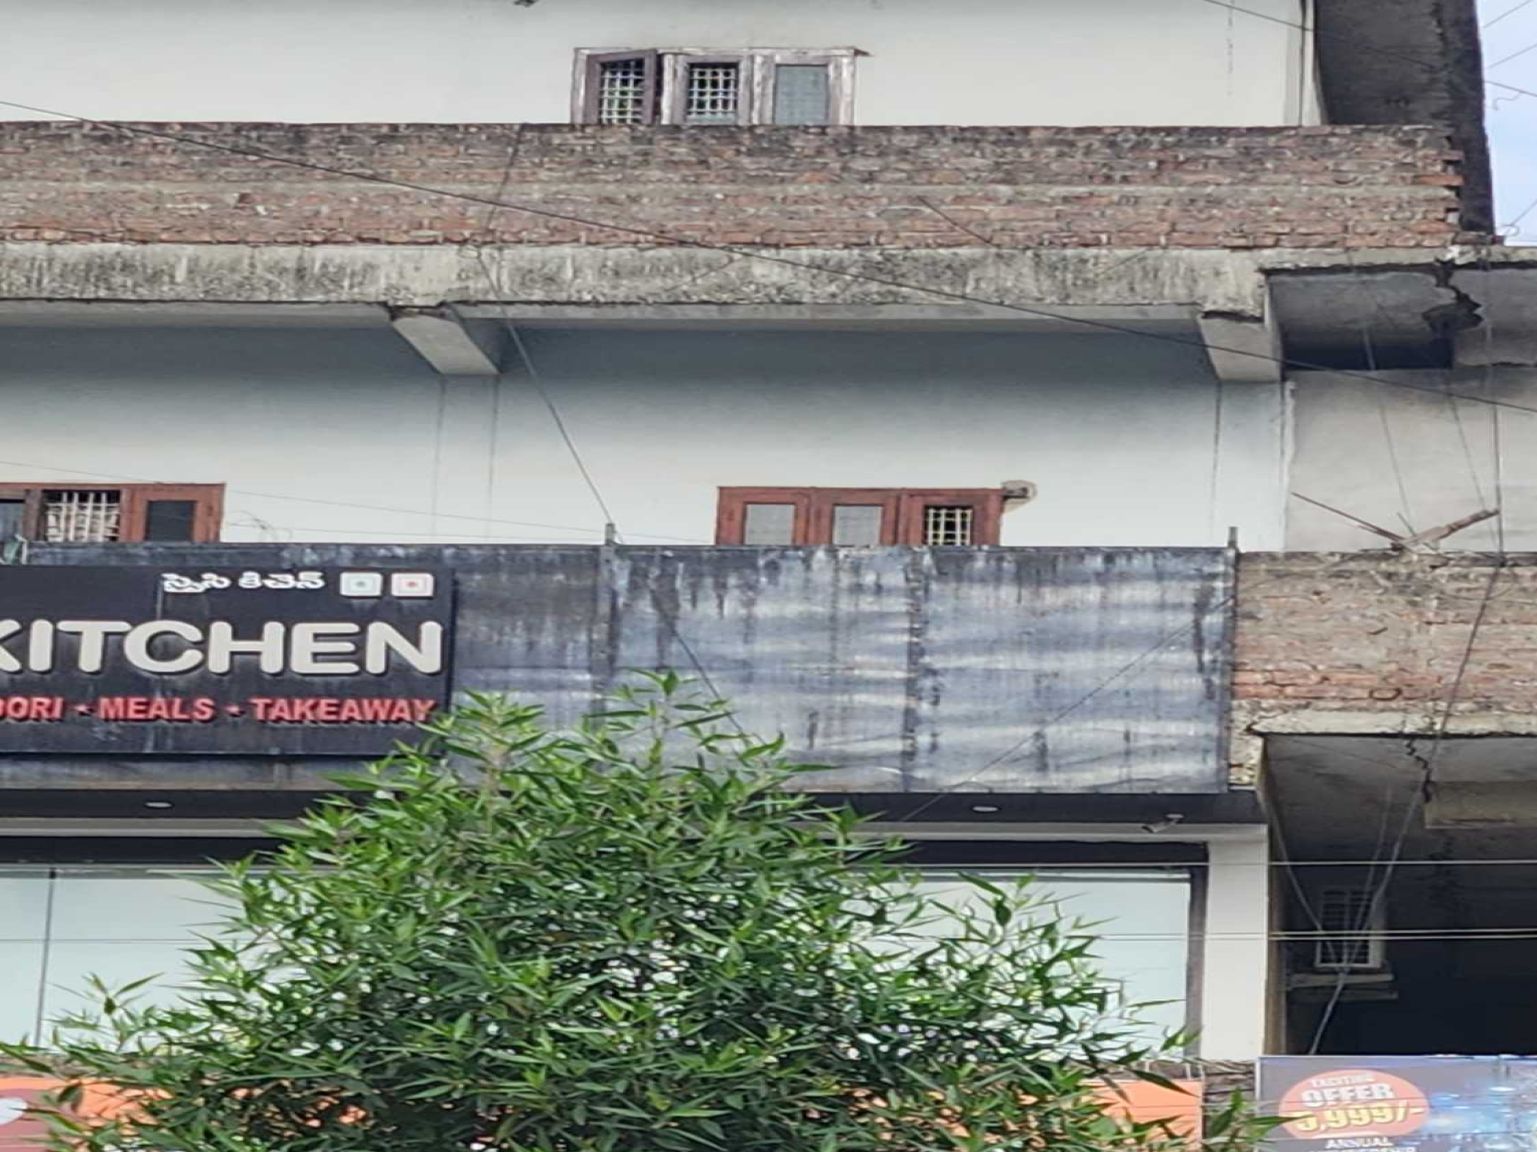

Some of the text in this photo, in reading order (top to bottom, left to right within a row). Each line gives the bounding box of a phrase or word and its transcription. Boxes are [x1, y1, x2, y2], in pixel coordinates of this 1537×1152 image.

[0, 696, 436, 723] ORI MEALS TAKEAWAY
[1301, 1082, 1396, 1108] OFFER
[1325, 1136, 1394, 1150] ANNUAL
